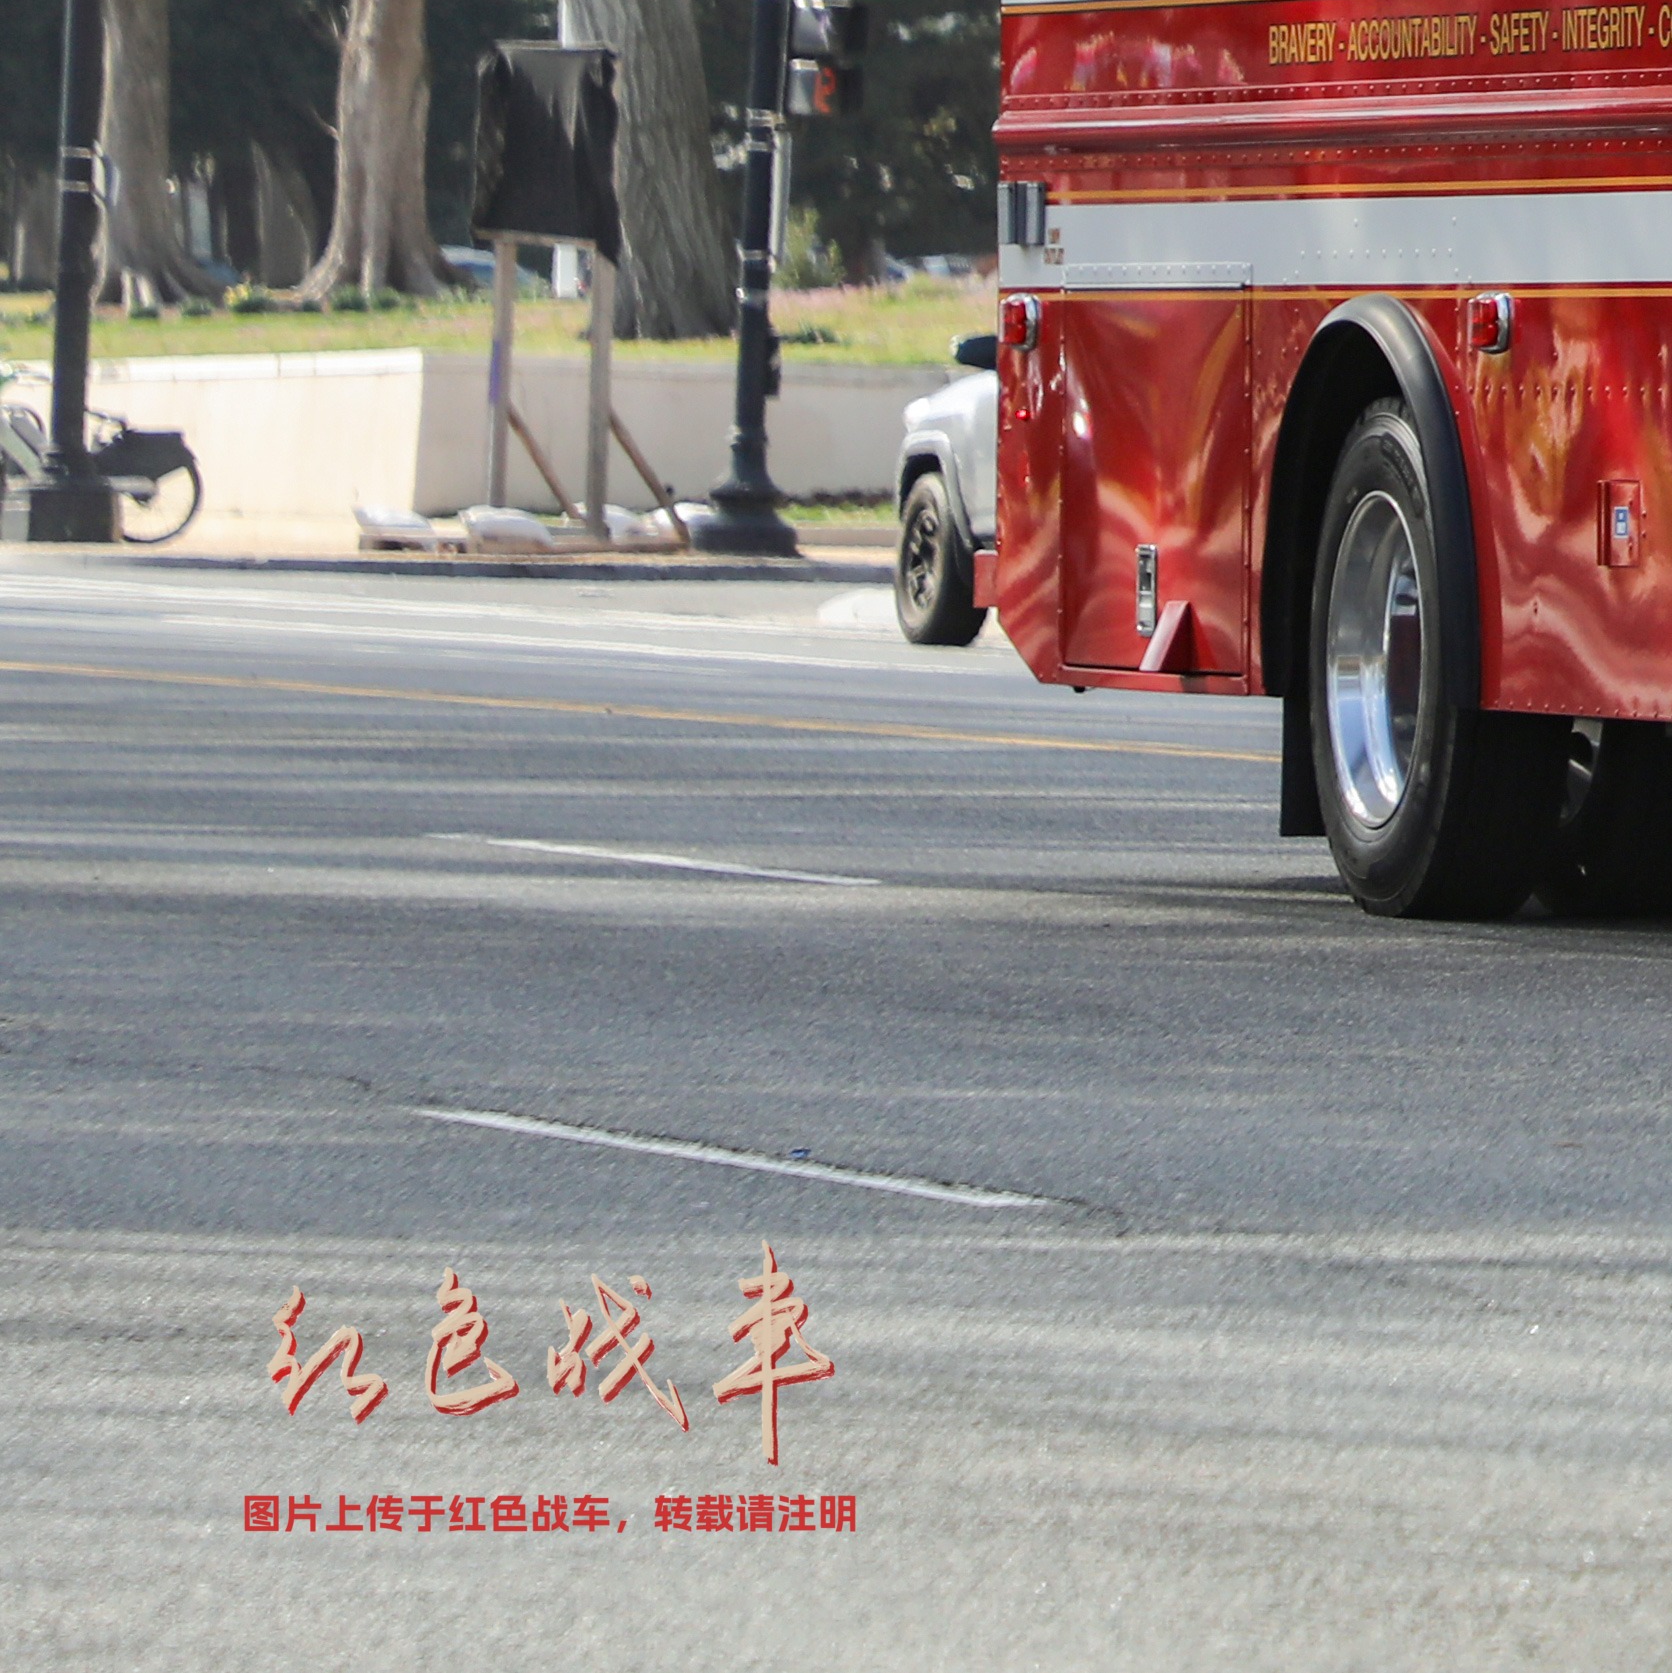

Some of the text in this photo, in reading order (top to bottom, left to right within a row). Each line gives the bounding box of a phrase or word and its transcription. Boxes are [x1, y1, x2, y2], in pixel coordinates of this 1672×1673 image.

[1268, 21, 1337, 65] BRAVERY
[1347, 14, 1478, 62] ACCOUNTABILITY
[1489, 10, 1550, 56] SAFETY
[1562, 5, 1647, 52] INTEGRITY
